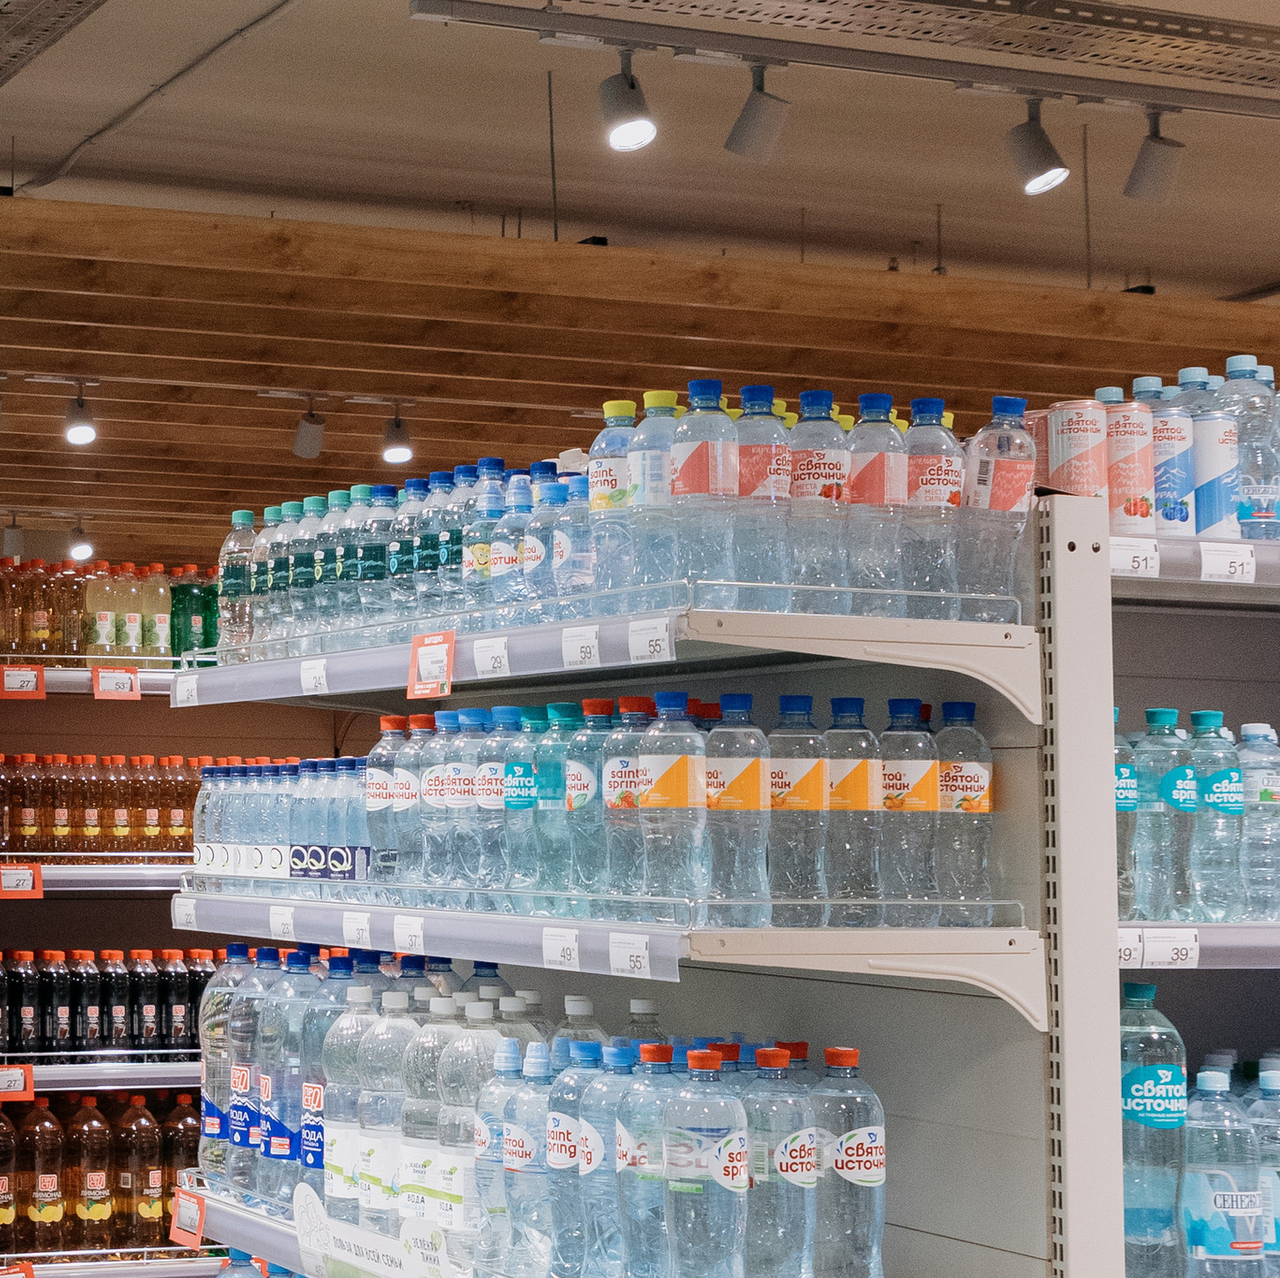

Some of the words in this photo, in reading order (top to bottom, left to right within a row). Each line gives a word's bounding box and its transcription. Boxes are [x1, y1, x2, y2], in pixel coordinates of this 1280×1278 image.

[798, 459, 843, 471] святой
[590, 467, 613, 479] saint
[793, 472, 847, 481] источник
[1131, 556, 1148, 570] 51
[1228, 561, 1245, 575] 51
[580, 645, 592, 660] 59
[648, 639, 662, 654] 55
[491, 656, 502, 669] 29
[20, 679, 30, 688] 27
[115, 681, 126, 690] 53
[610, 769, 639, 779] saint
[15, 879, 26, 887] 27
[356, 928, 365, 941] 37
[408, 934, 418, 948] 37
[561, 947, 572, 961] 49
[1171, 947, 1189, 962] 39
[629, 955, 642, 970] 55
[6, 1079, 18, 1088] 27
